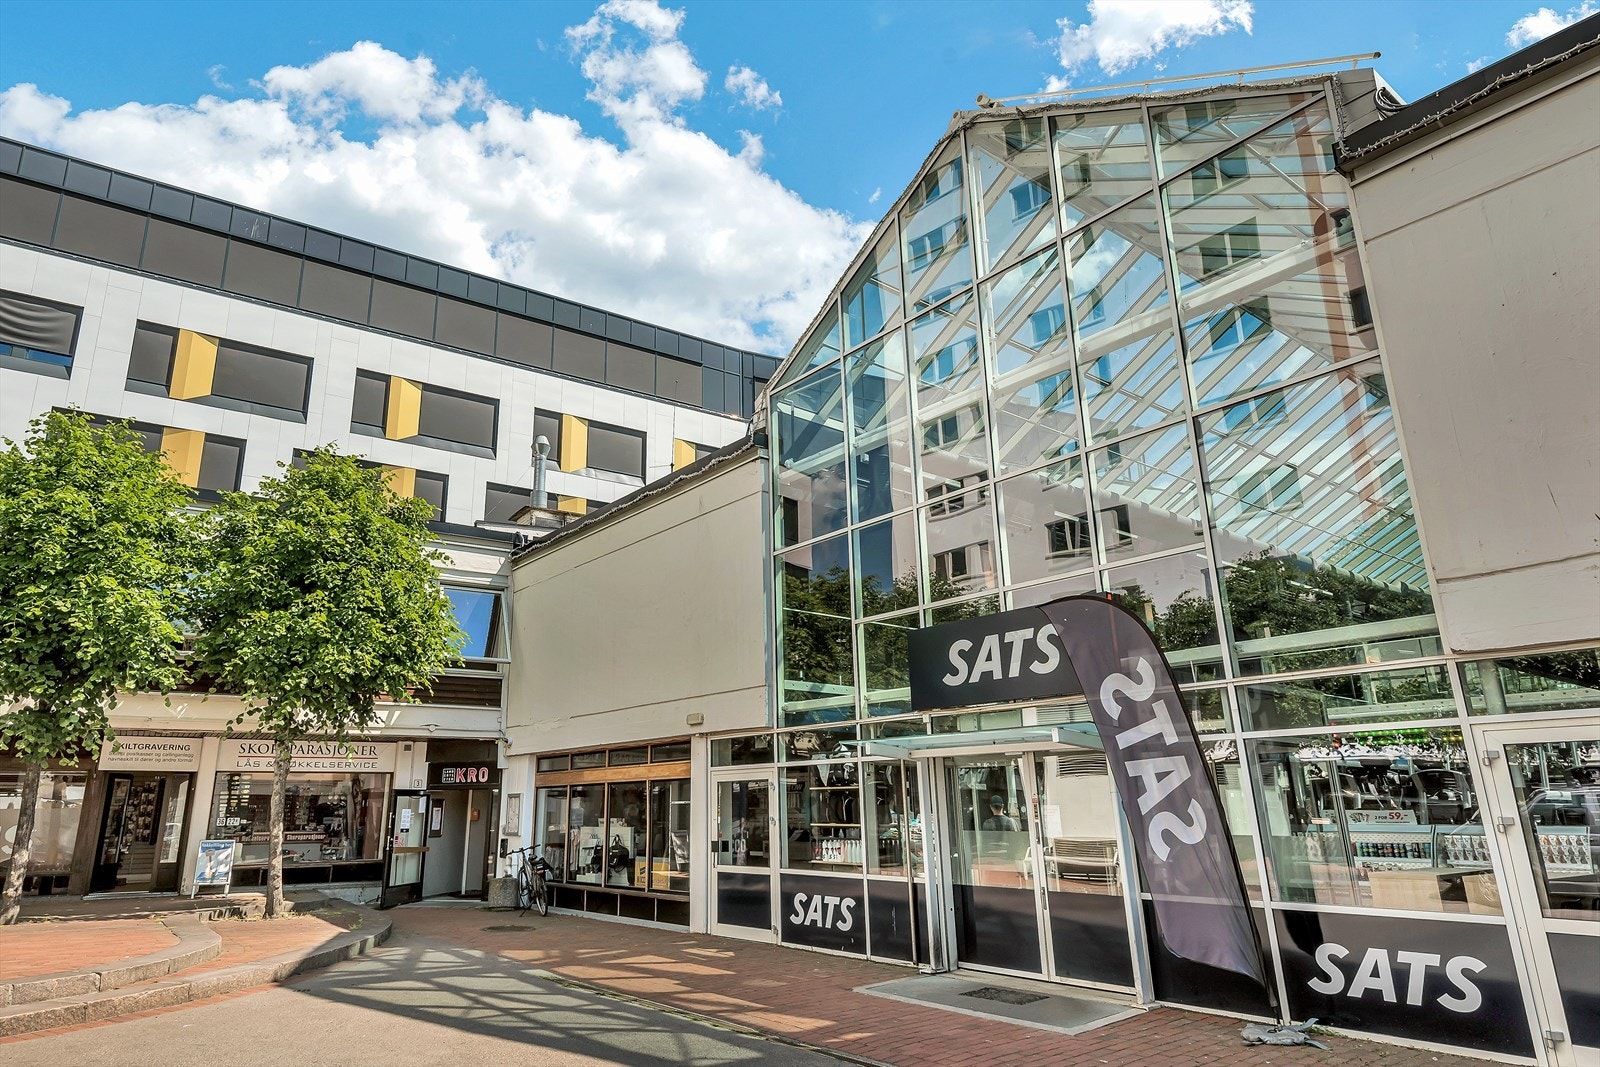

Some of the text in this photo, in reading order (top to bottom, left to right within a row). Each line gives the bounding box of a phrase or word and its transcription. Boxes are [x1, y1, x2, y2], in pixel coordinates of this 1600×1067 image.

[942, 623, 1062, 687] SATS
[236, 758, 378, 769] LÅS & ØKKELSERVICE
[455, 767, 489, 783] KRO
[789, 892, 857, 931] SATS
[1307, 942, 1488, 1013] SATS
